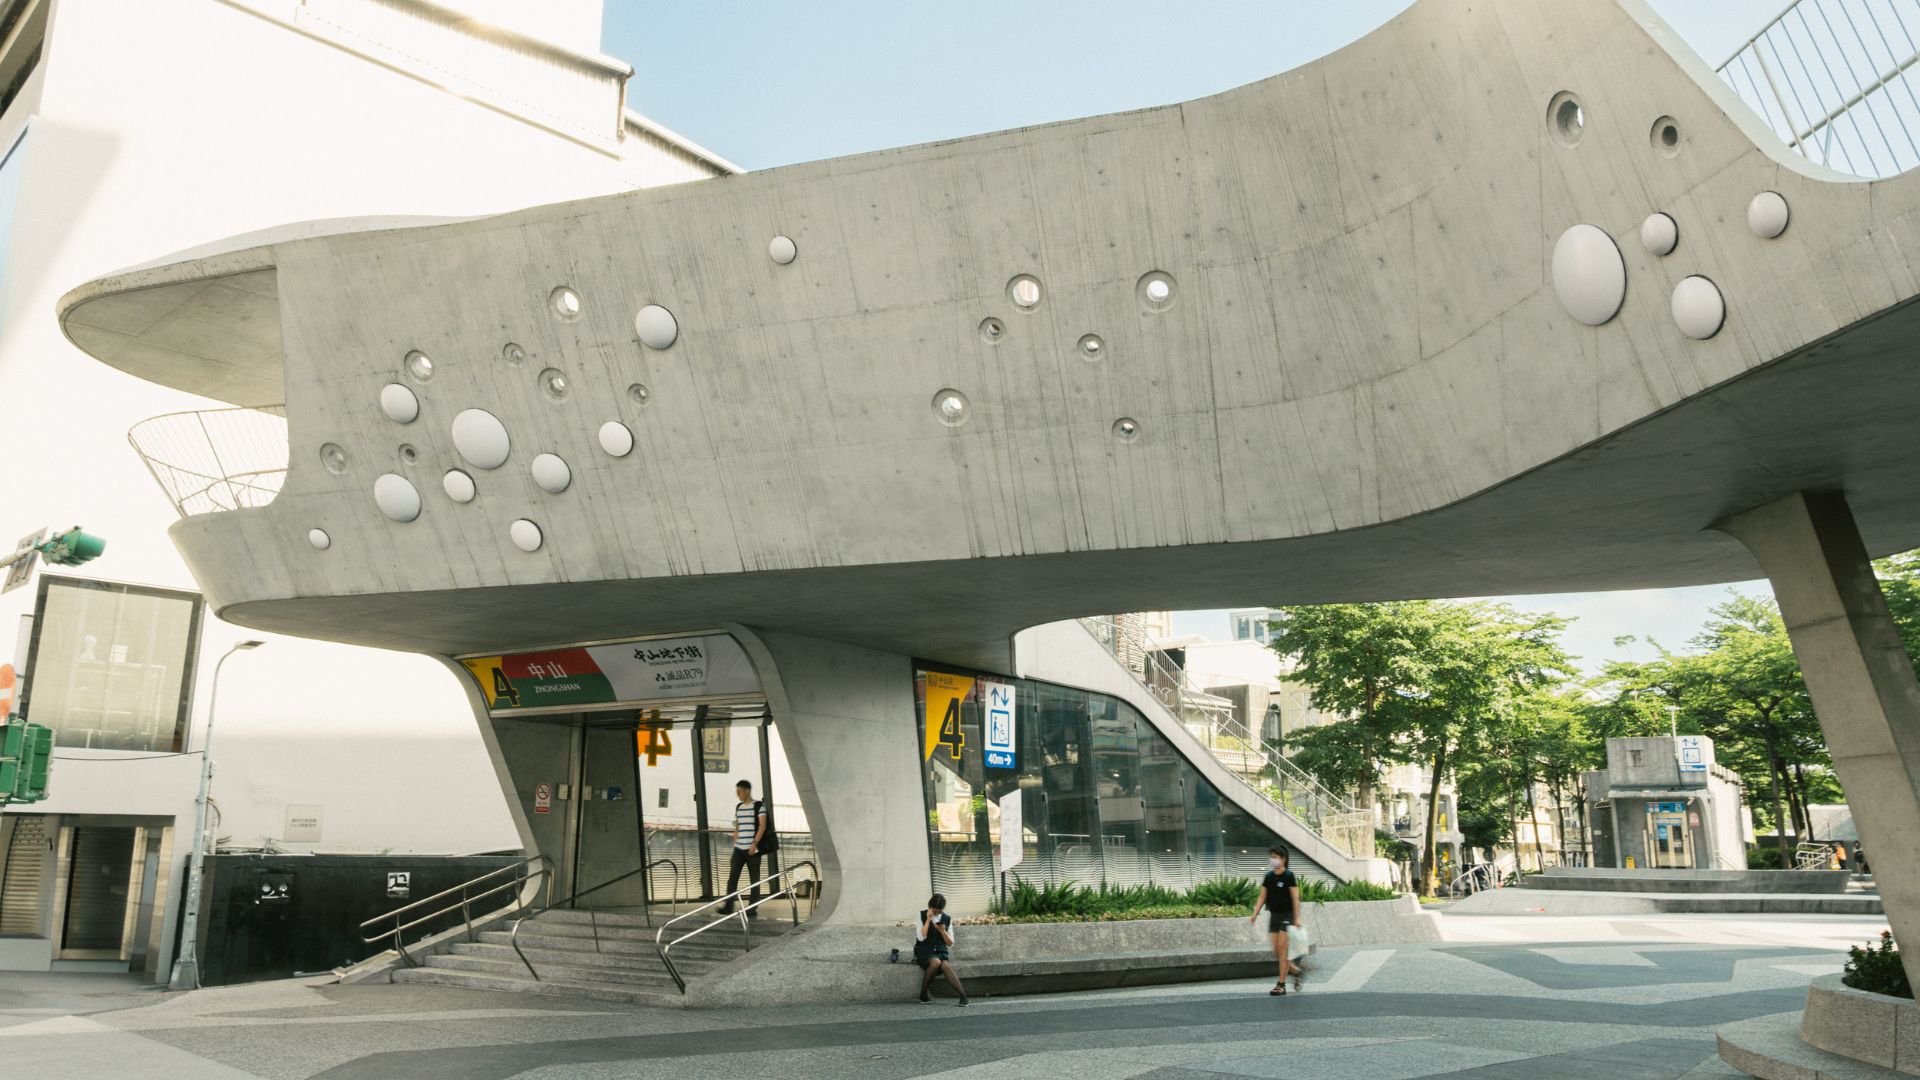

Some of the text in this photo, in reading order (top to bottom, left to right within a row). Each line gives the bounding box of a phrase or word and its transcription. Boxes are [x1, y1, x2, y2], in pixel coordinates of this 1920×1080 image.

[634, 645, 703, 663] 中山地下街
[527, 661, 568, 680] 中山
[491, 666, 520, 707] 4
[534, 682, 582, 694] ZHONGSHAN
[939, 697, 965, 760] 4
[987, 753, 1004, 765] 40m
